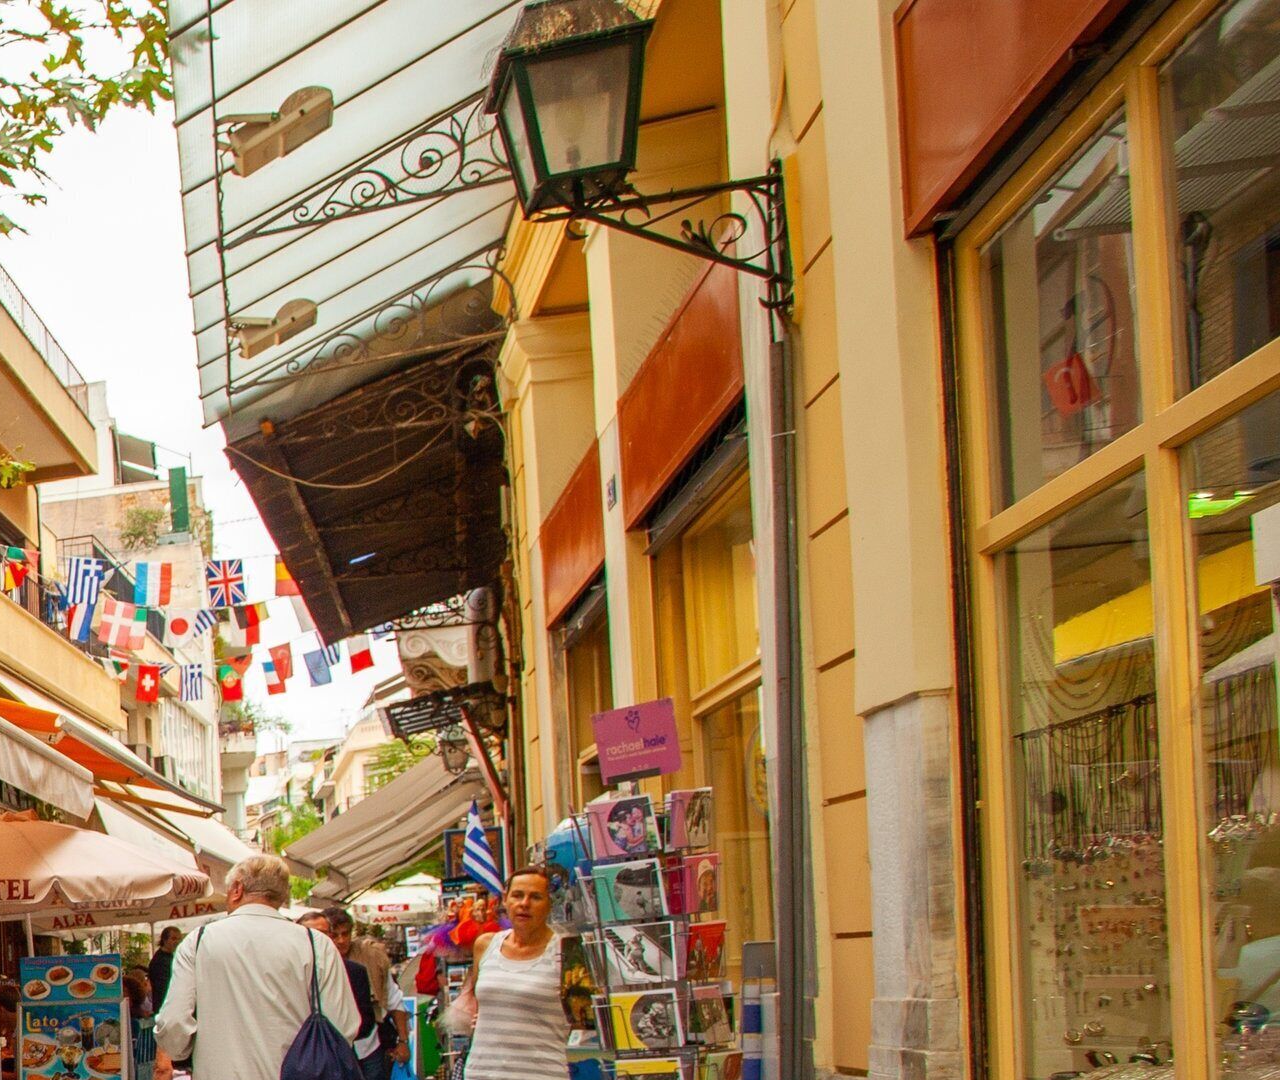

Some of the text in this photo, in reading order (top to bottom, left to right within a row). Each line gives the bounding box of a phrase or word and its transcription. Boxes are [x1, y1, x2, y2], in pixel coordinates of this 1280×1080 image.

[169, 903, 218, 919] ALFA
[52, 914, 96, 929] ALFA
[26, 1012, 58, 1033] Lato
